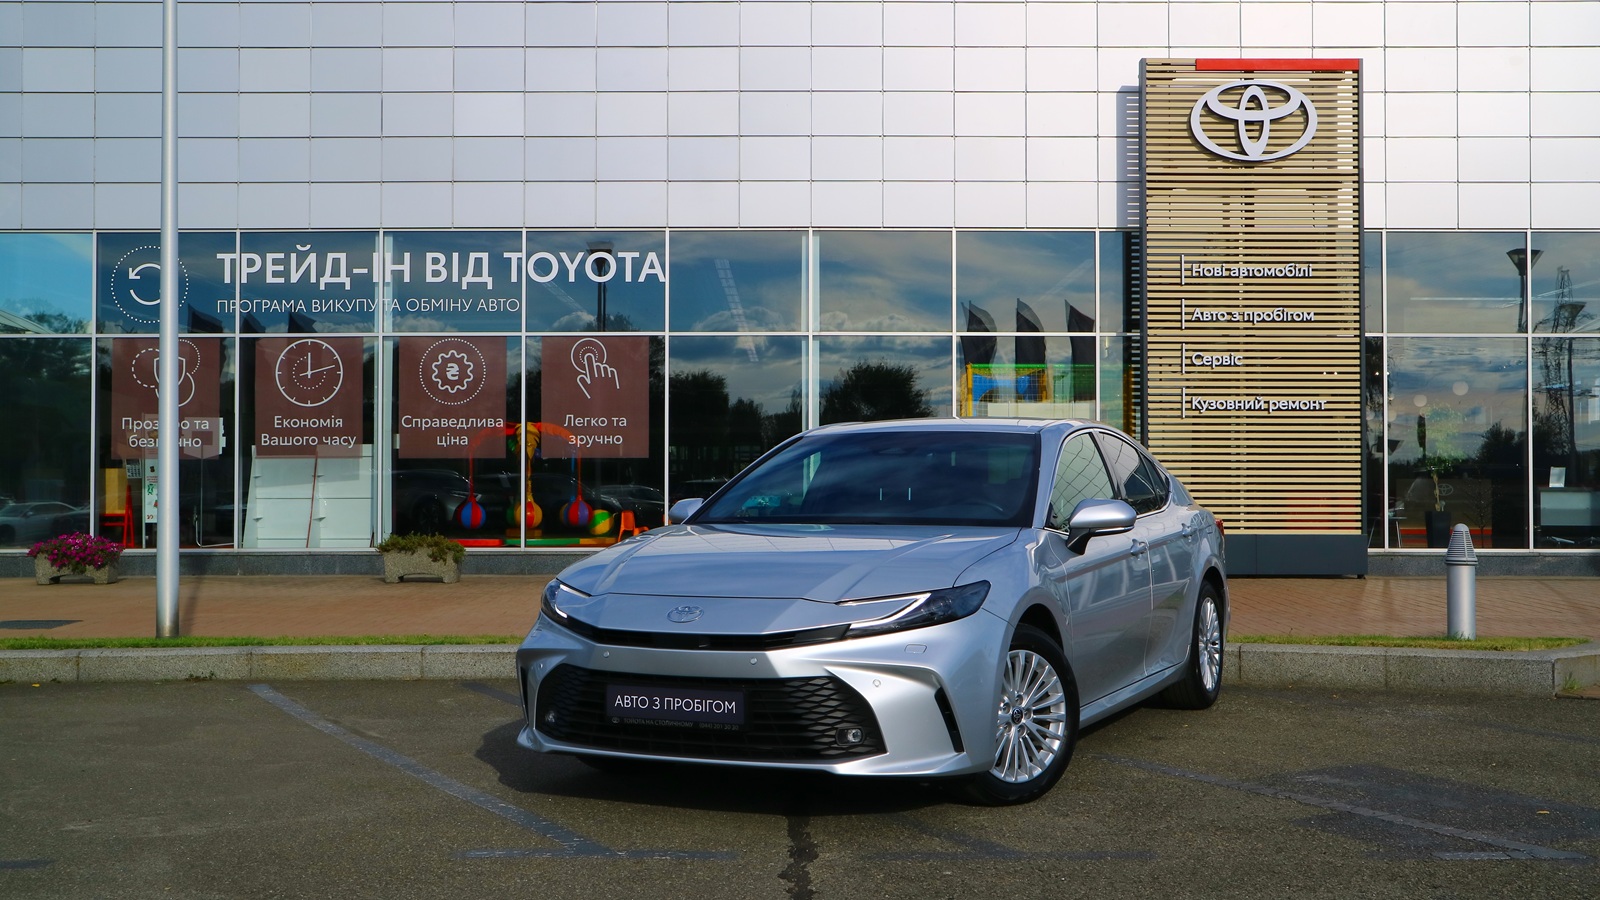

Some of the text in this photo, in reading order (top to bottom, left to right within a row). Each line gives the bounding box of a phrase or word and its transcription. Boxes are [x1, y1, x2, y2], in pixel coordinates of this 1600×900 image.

[217, 244, 410, 290] ТРЕЙД-ІН
[426, 252, 493, 290] ВІД
[1191, 263, 1313, 278] Нові автомобілі
[217, 298, 520, 313] ПРОГРАМА ВИКУПУ ТА ОБМІНУ АВТО
[1191, 307, 1315, 325] Авто з пробігом
[1191, 352, 1243, 369] Сервіс
[1191, 396, 1326, 414] Кузовний ремонт
[122, 417, 209, 433] Прозо та
[274, 416, 343, 429] Економія
[401, 415, 504, 431] Справедлива
[563, 415, 627, 428] Легко та
[261, 433, 357, 449] Вашого часу
[436, 433, 468, 448] ціна
[568, 433, 623, 448] зручно
[614, 695, 649, 709] АВТО
[664, 698, 736, 714] ПРОБІГОМ
